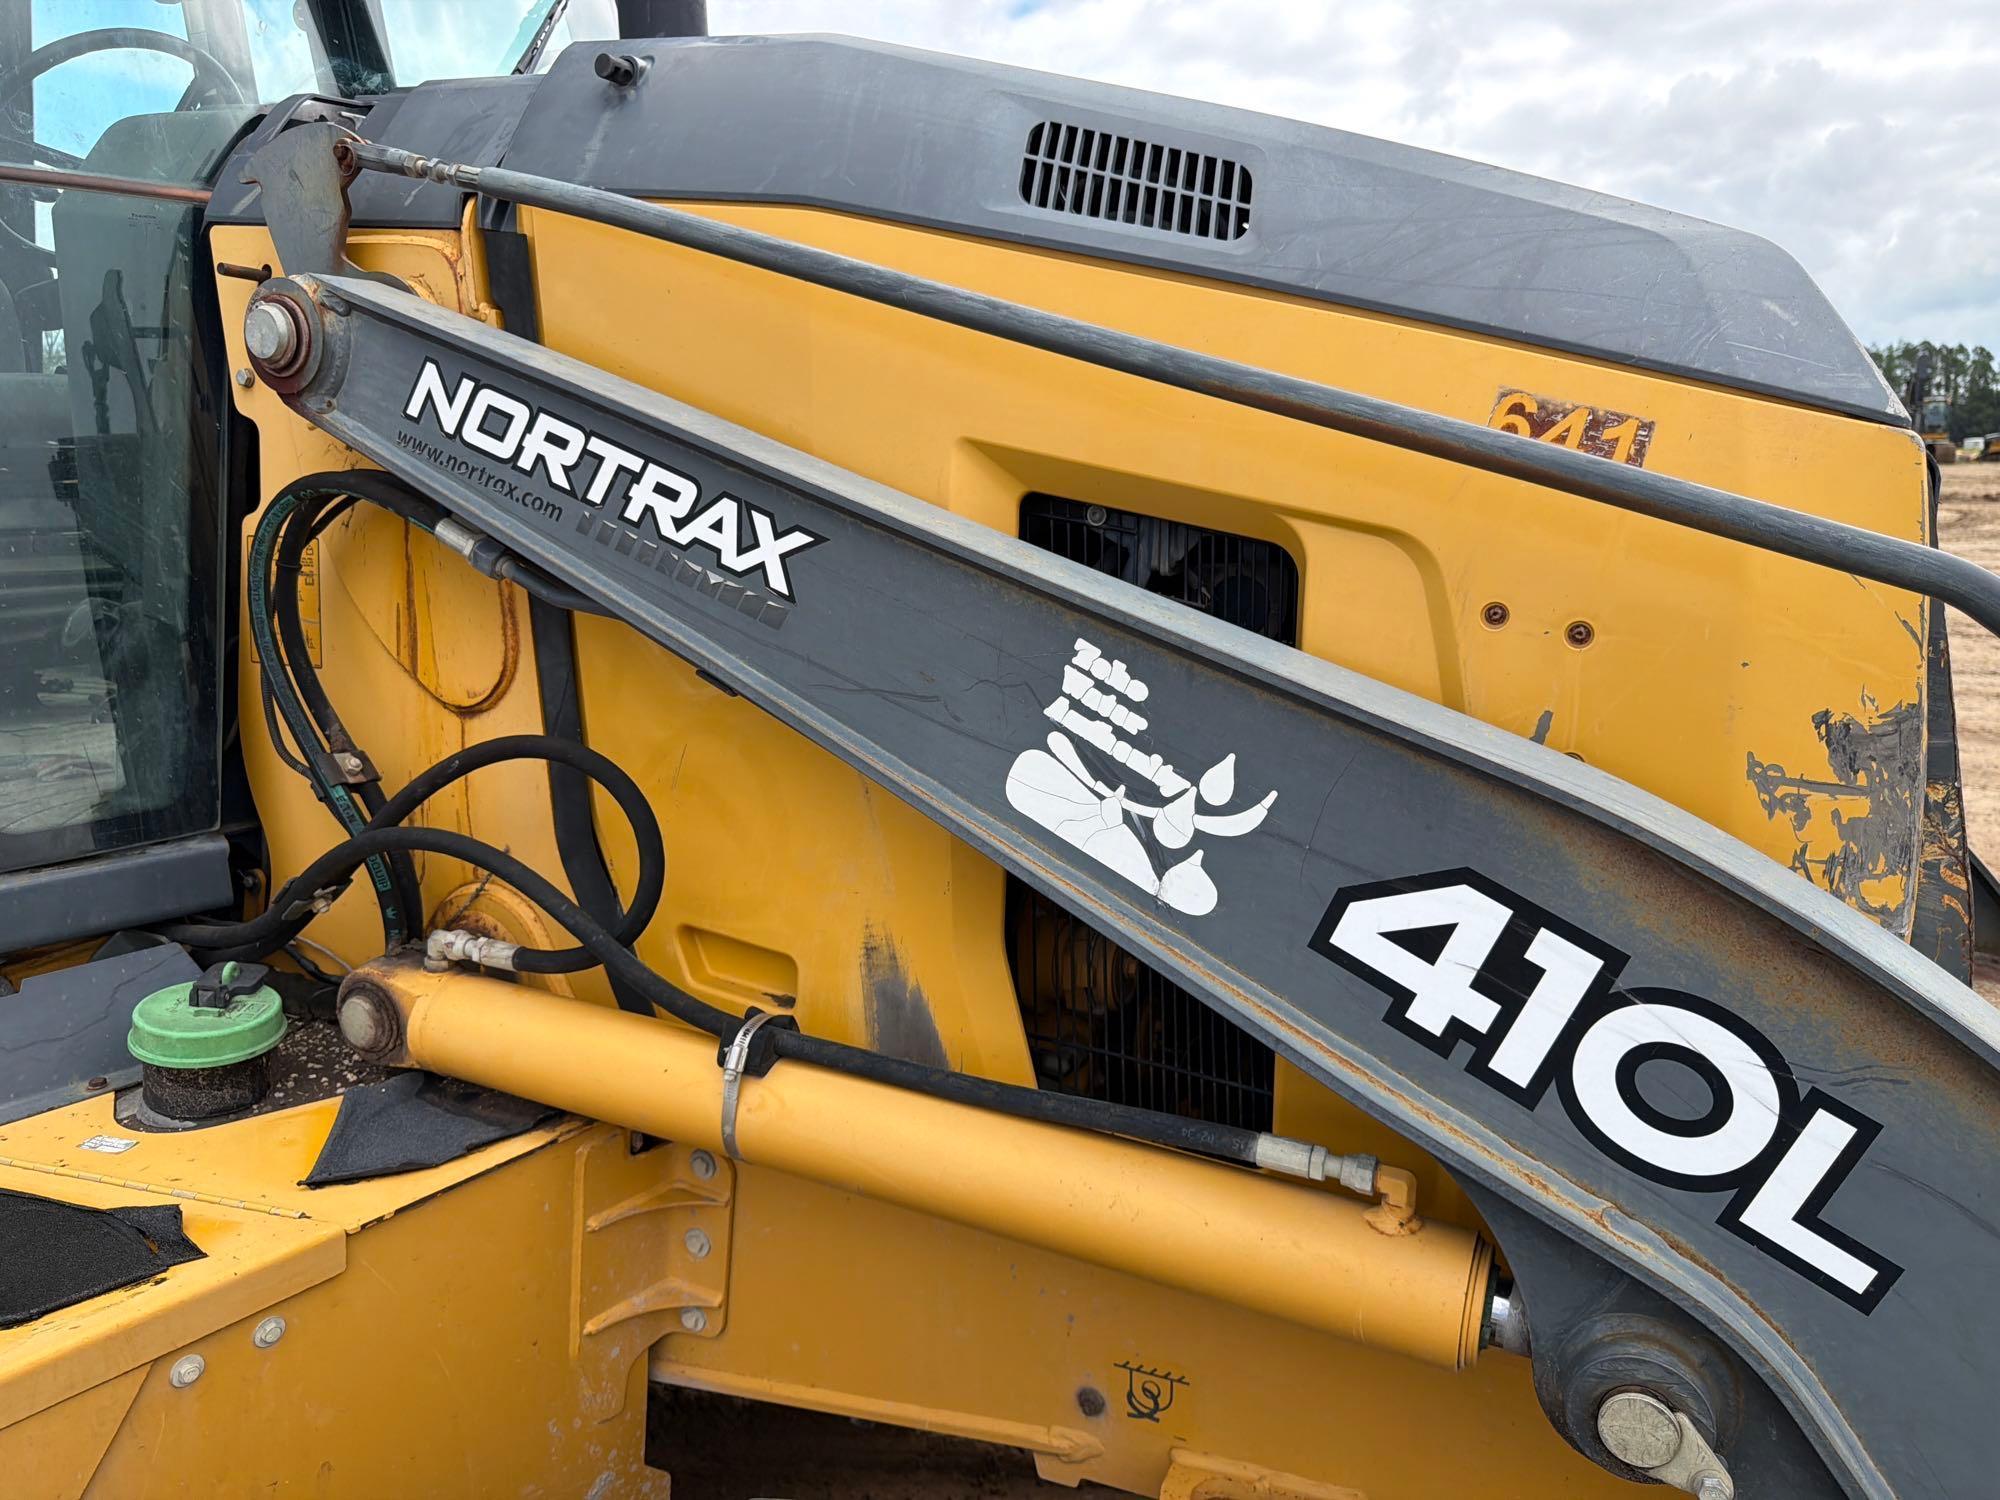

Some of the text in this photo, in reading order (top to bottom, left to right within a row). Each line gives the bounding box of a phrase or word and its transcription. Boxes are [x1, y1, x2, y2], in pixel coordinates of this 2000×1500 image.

[397, 430, 563, 522] www.nortrax.com
[403, 358, 820, 599] NORTRAX
[1325, 880, 1884, 1299] 410L
